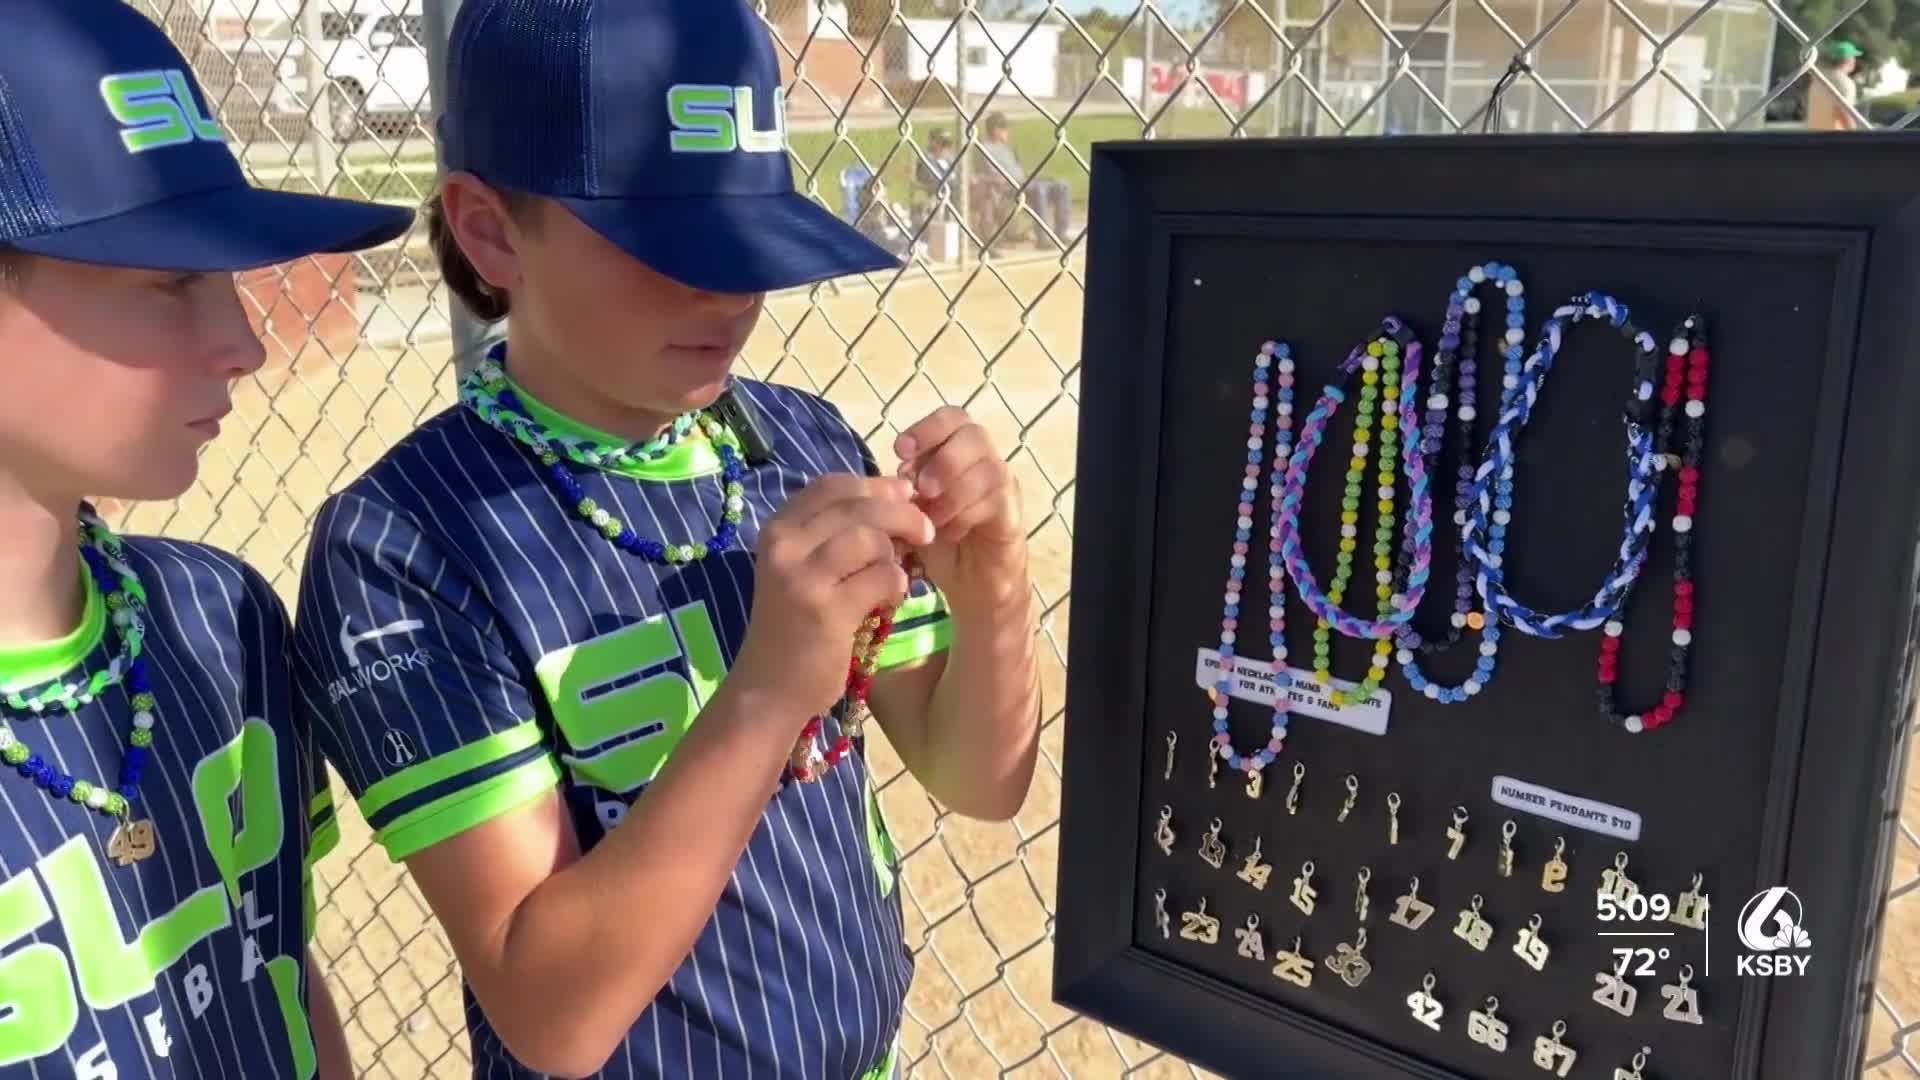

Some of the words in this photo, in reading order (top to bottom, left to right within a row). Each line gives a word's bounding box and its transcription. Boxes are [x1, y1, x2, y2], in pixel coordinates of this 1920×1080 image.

[667, 84, 785, 153] SL
[1501, 785, 1546, 807] NUMBER
[1550, 800, 1608, 824] PENDANTS
[1612, 815, 1632, 830] $10
[1447, 826, 1465, 860] 7
[1289, 877, 1317, 916] 15
[1389, 895, 1435, 931] 17
[1272, 951, 1314, 987] 25
[1512, 928, 1549, 971] 19
[1407, 991, 1443, 1032] 42
[1592, 972, 1637, 1017] 20
[1661, 984, 1704, 1025] 21
[1468, 1010, 1509, 1052] 66
[1533, 1036, 1577, 1077] 87
